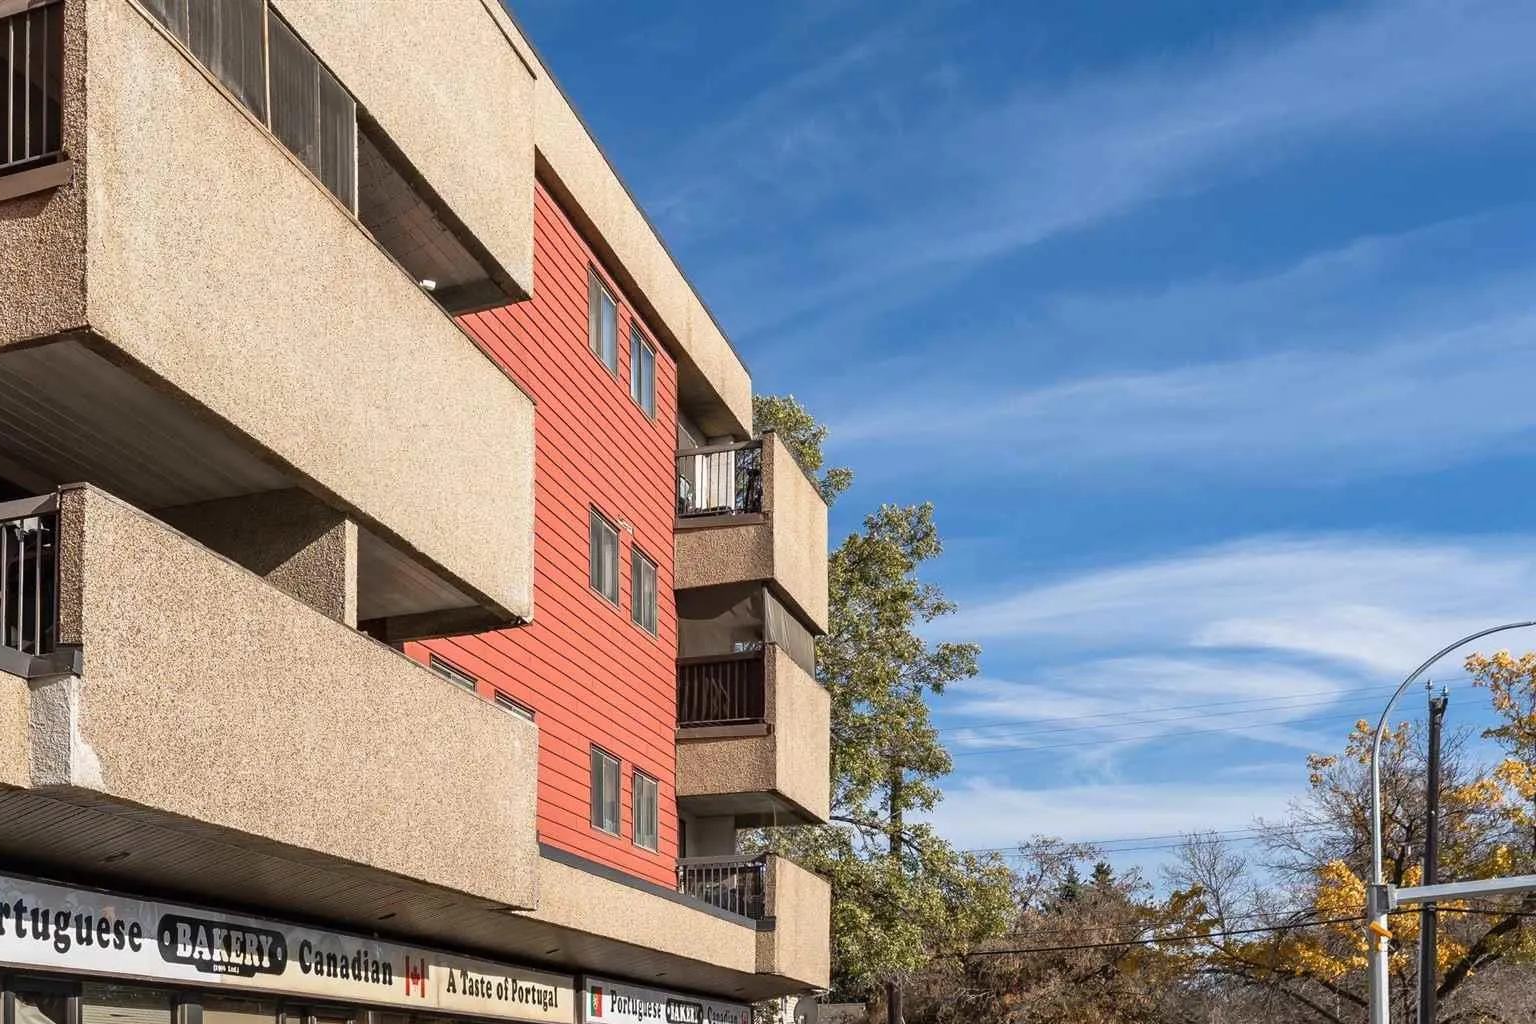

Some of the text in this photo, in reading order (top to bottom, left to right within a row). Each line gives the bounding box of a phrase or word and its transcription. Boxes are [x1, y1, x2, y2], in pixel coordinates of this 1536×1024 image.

[176, 922, 274, 968] BAKERY
[299, 939, 393, 986] Canadian
[447, 968, 558, 1012] A Taste of Portugal
[610, 990, 662, 1021] Portuguese
